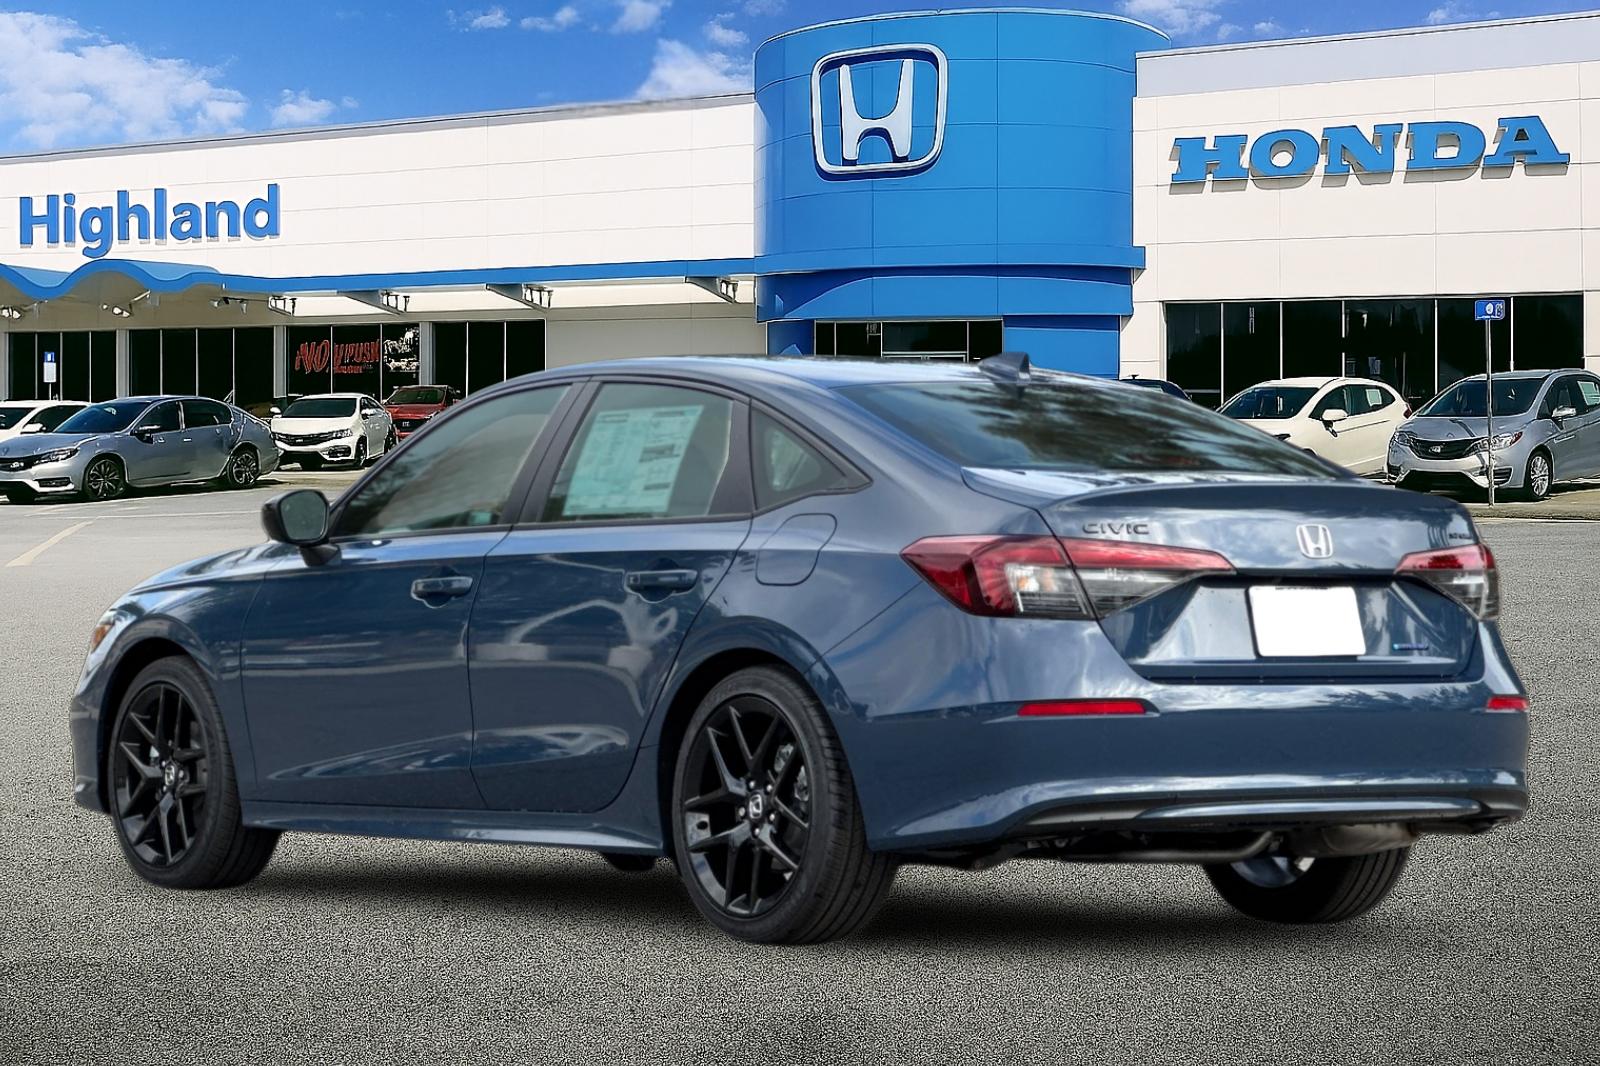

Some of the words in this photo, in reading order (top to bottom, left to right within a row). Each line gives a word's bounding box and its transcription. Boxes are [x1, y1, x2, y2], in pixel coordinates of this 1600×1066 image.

[1170, 115, 1570, 187] HONDA
[19, 183, 280, 259] Highland
[1082, 522, 1150, 535] CIVIC
